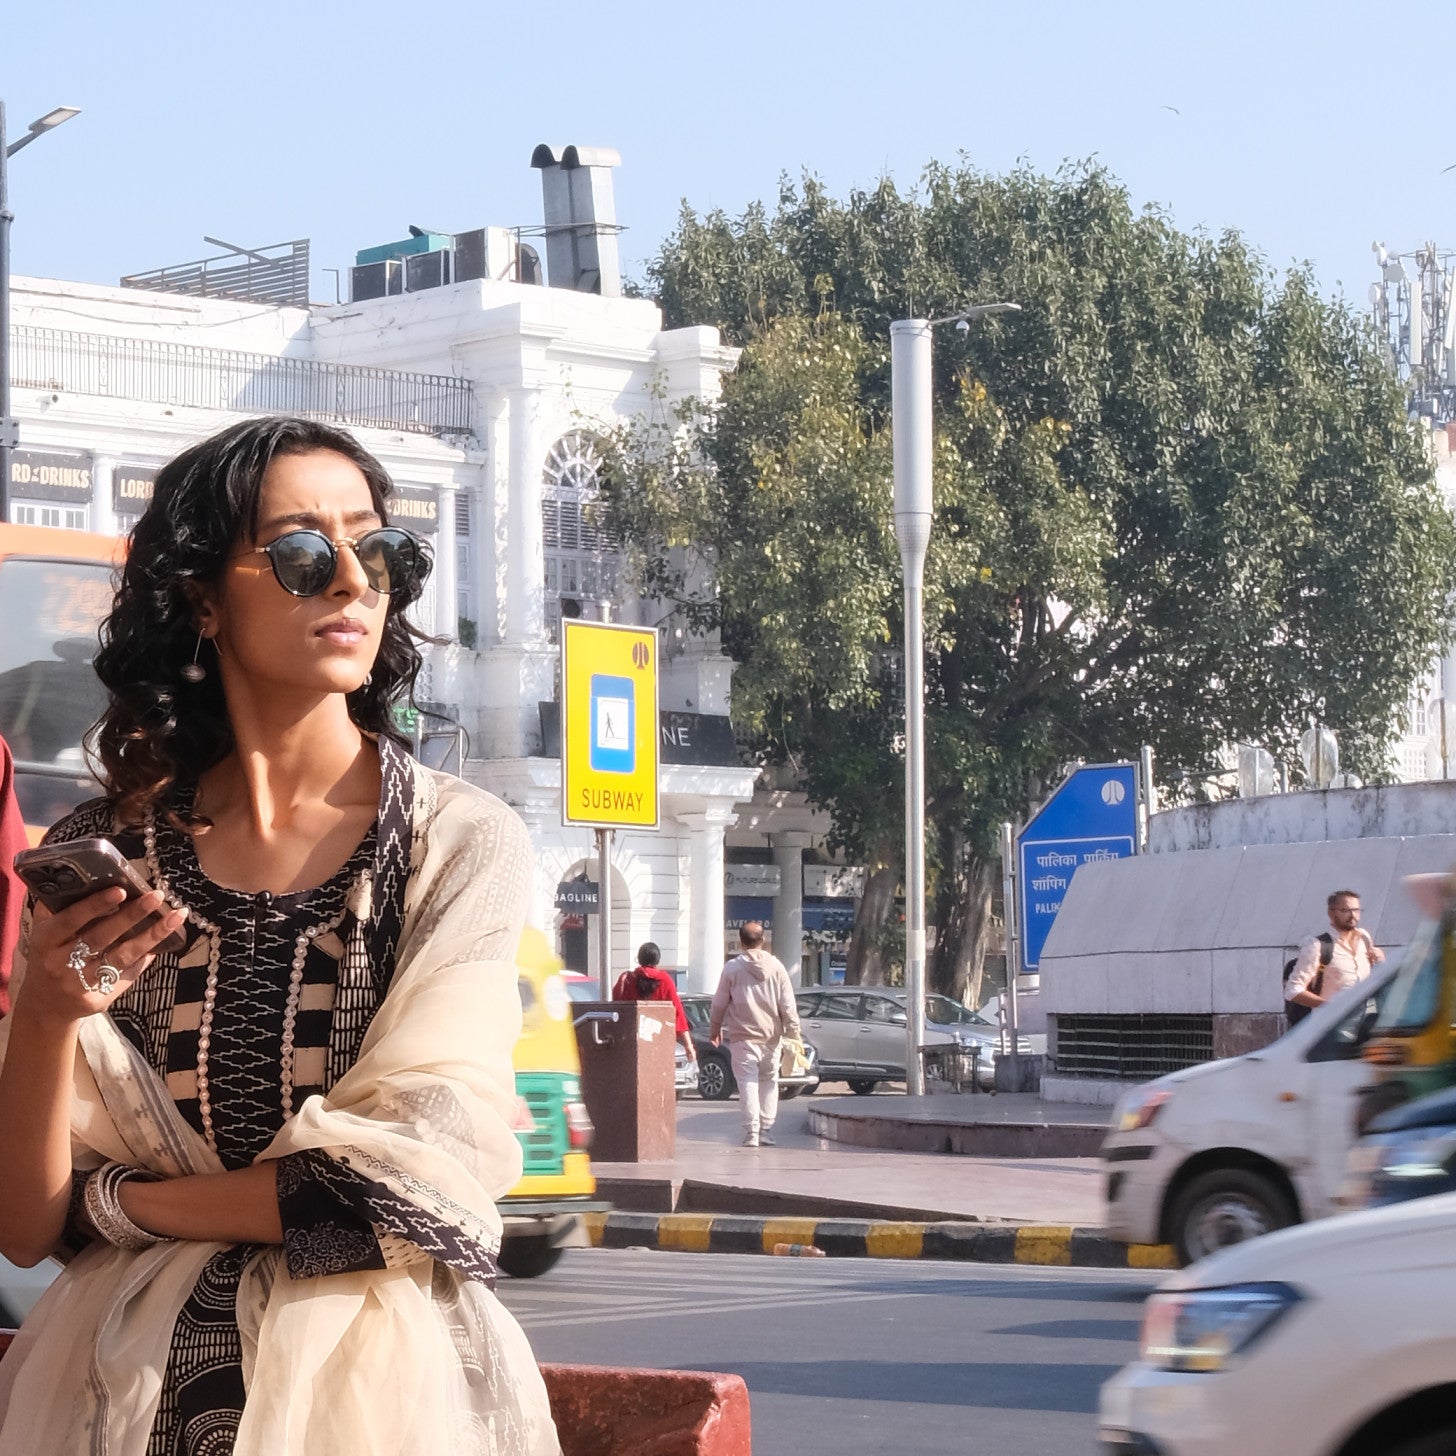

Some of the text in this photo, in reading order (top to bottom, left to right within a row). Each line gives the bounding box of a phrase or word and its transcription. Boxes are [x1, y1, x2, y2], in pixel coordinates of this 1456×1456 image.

[11, 463, 31, 483] RD
[40, 466, 90, 488] DRINKS
[392, 498, 437, 520] DRINKS
[662, 727, 692, 747] NE
[582, 788, 644, 812] SUBWAY
[1036, 852, 1077, 867] पालिका
